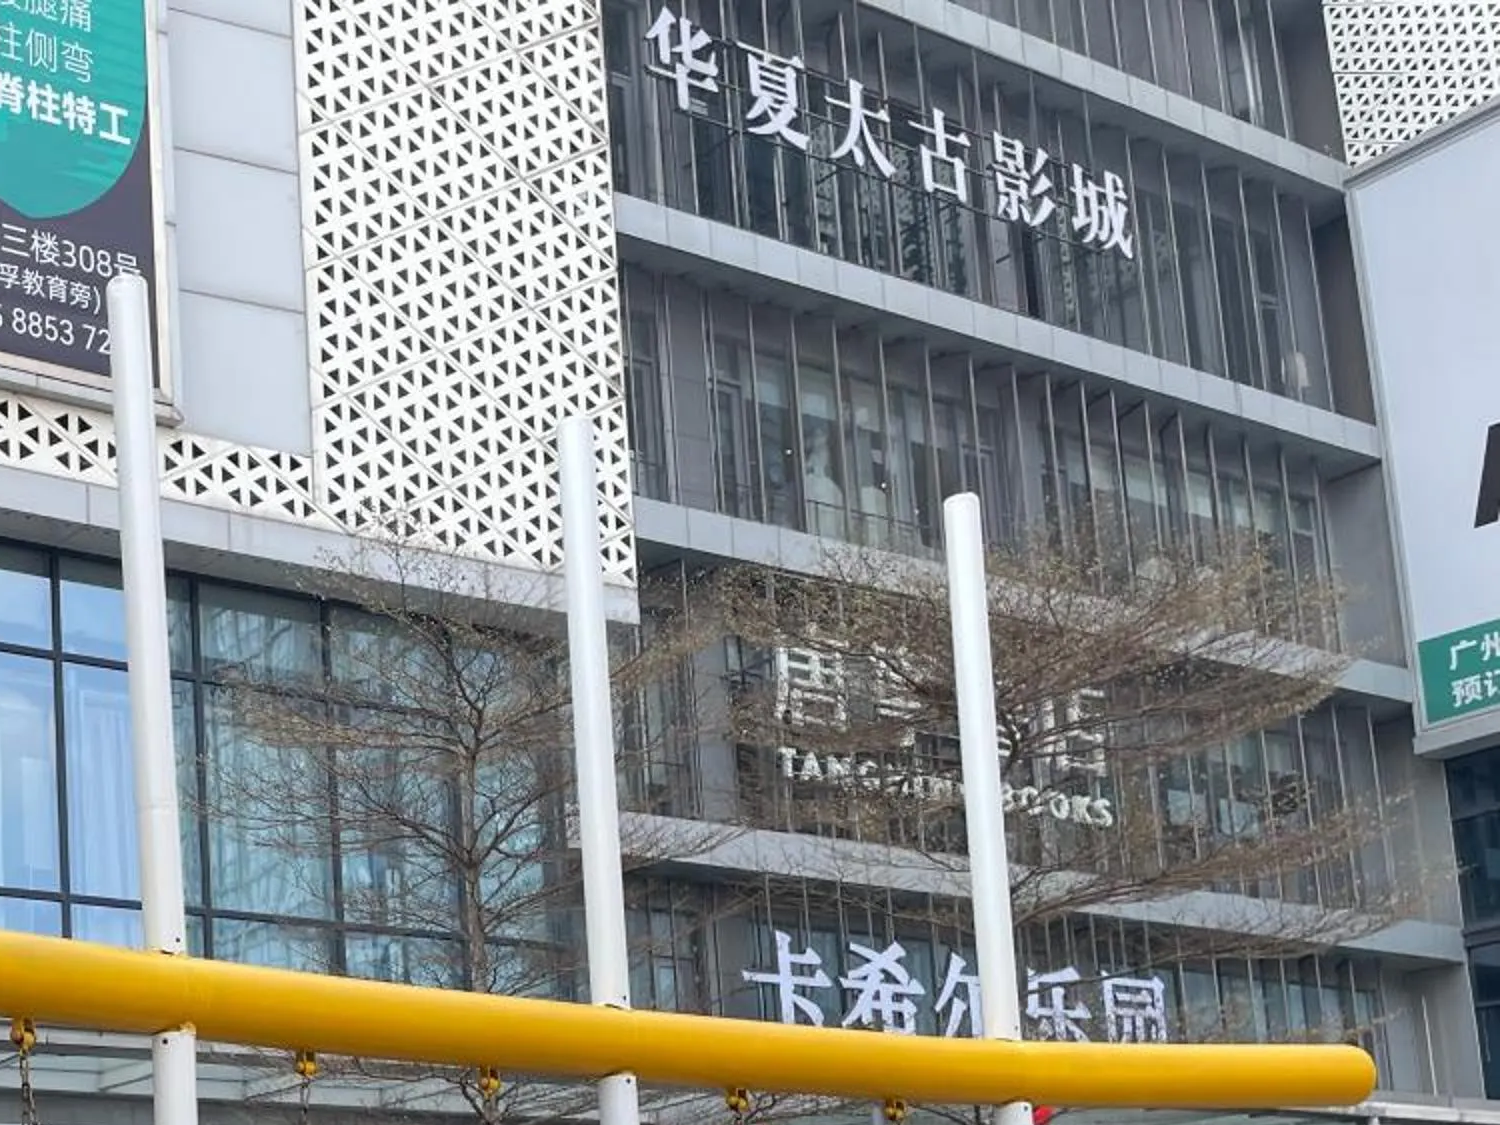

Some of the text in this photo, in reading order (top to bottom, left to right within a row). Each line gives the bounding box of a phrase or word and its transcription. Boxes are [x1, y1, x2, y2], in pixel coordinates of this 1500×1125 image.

[644, 5, 1134, 259] 华夏太古影城
[12, 308, 75, 345] 8853
[82, 324, 112, 356] 72
